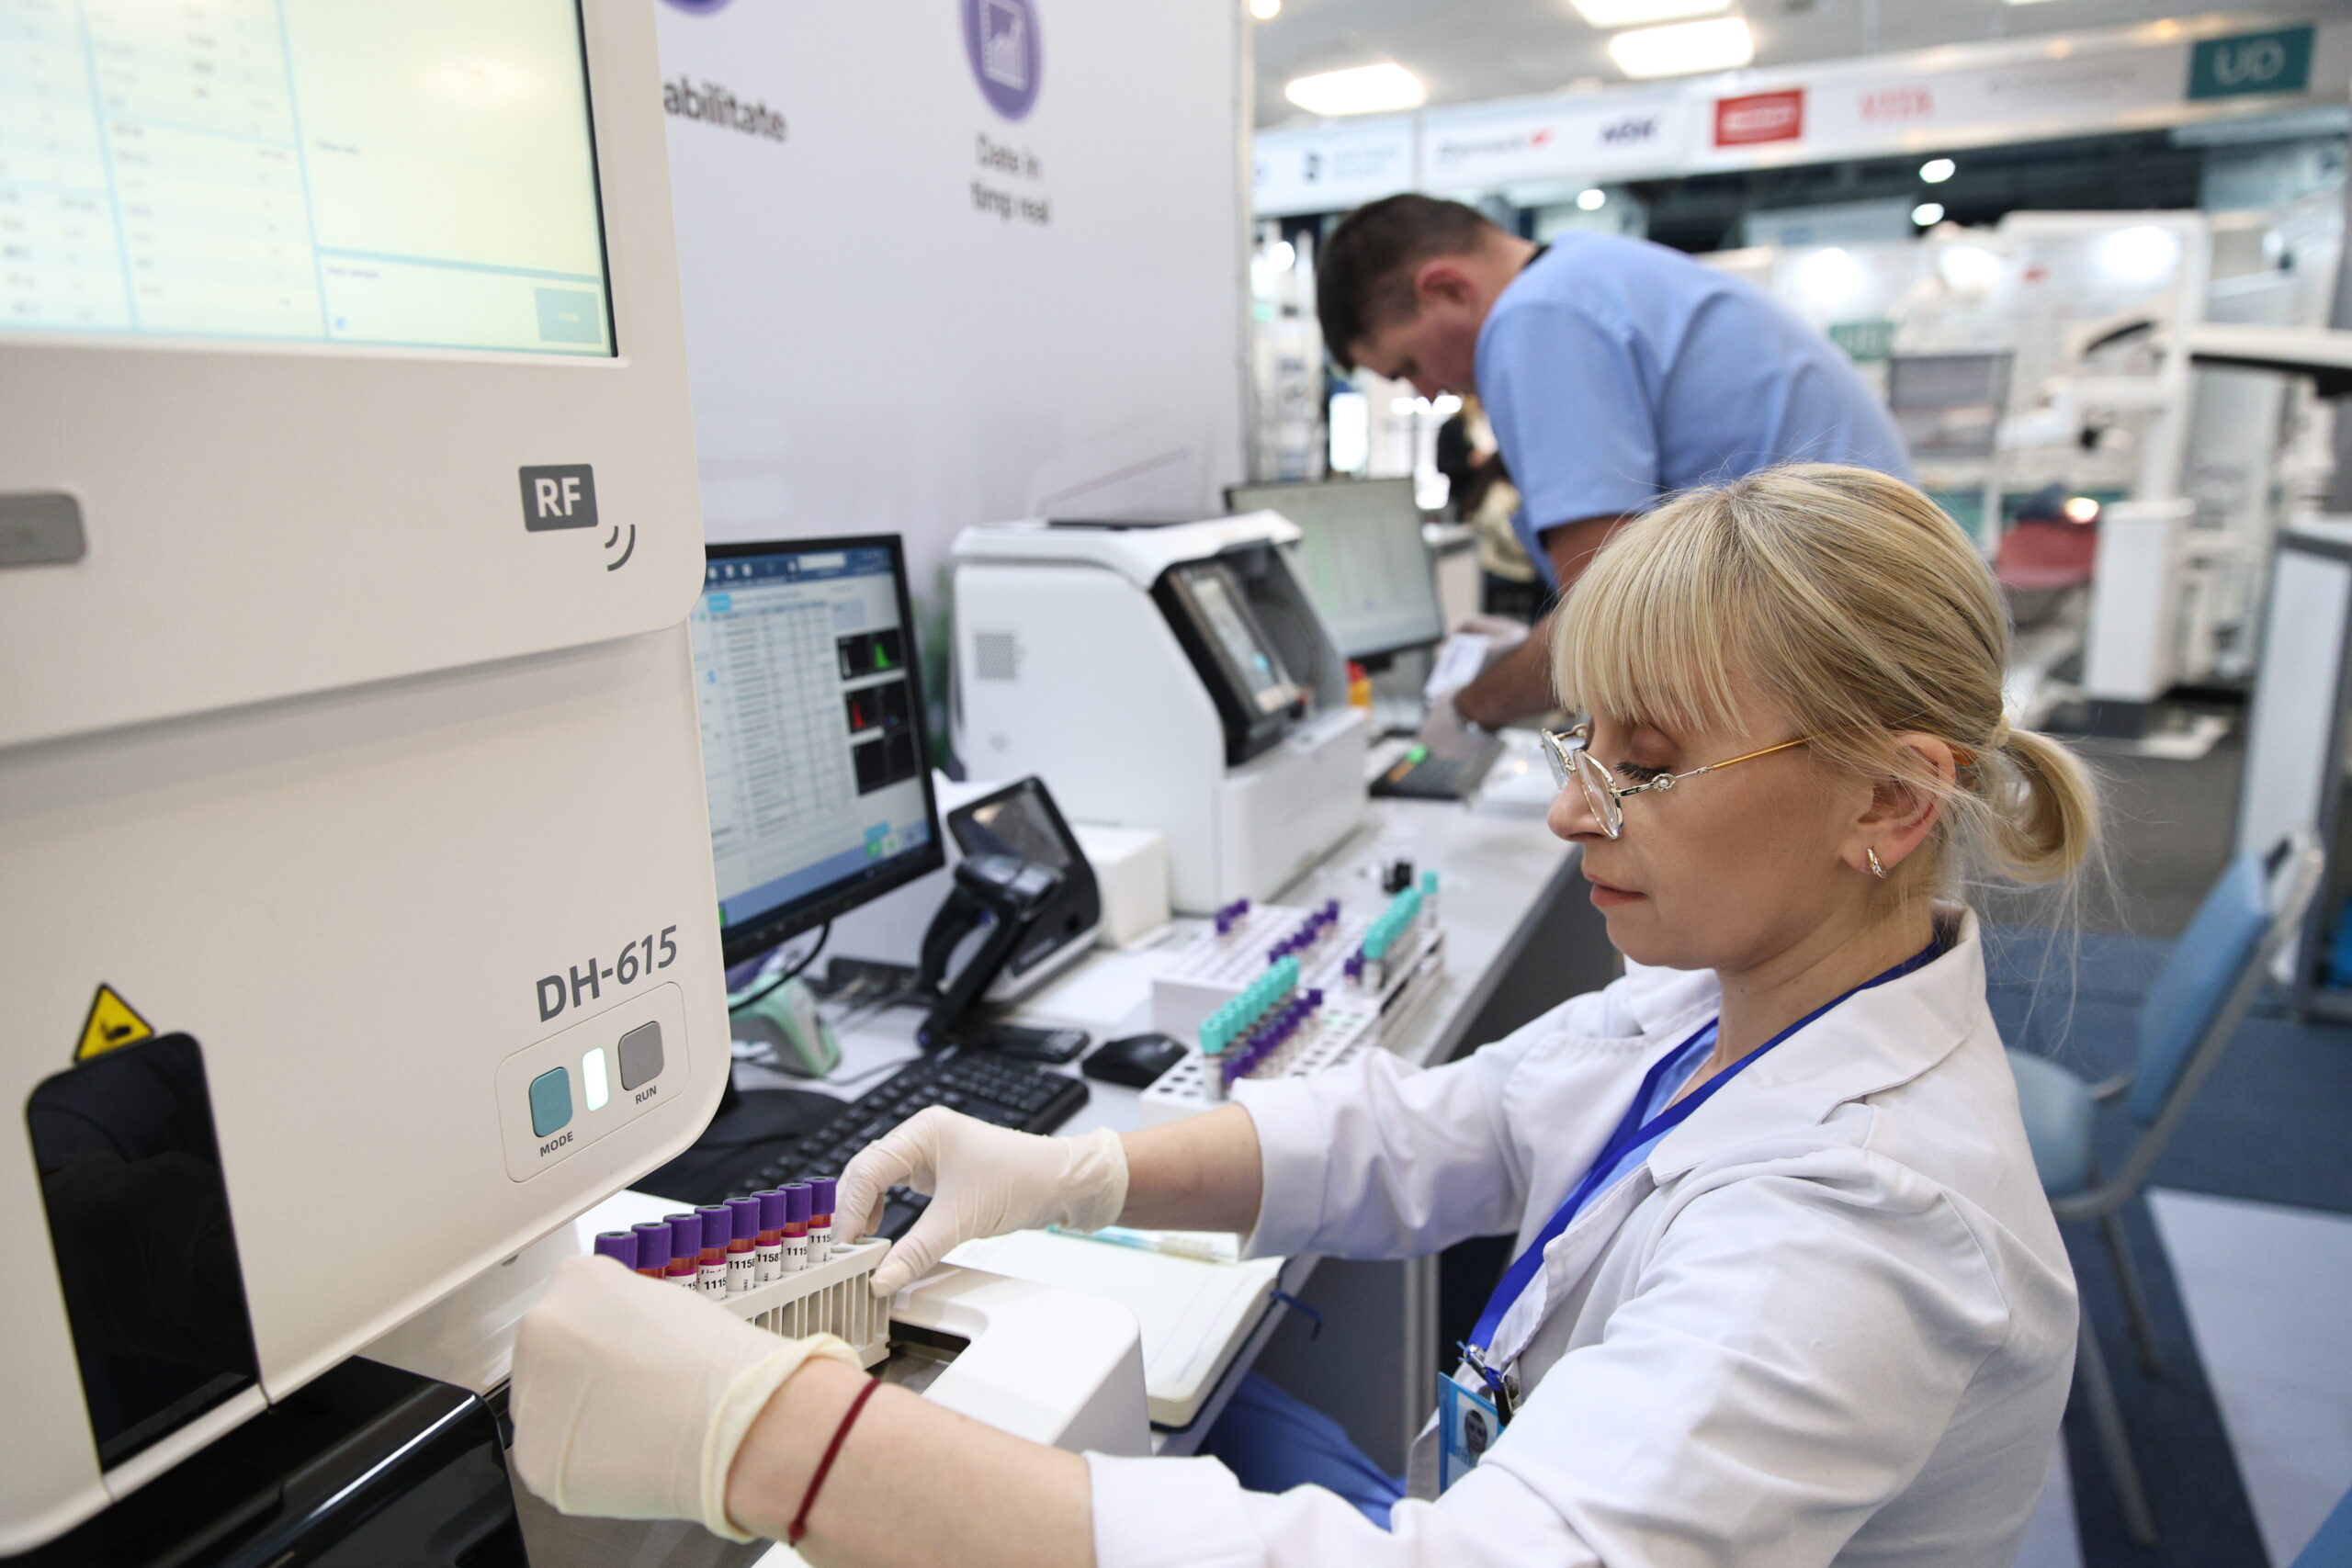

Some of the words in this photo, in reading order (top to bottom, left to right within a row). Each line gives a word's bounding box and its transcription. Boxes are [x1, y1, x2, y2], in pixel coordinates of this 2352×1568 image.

[535, 477, 582, 518] RF
[537, 924, 677, 1022] DH-615
[635, 1086, 658, 1105] RUN
[539, 1131, 574, 1157] MODE
